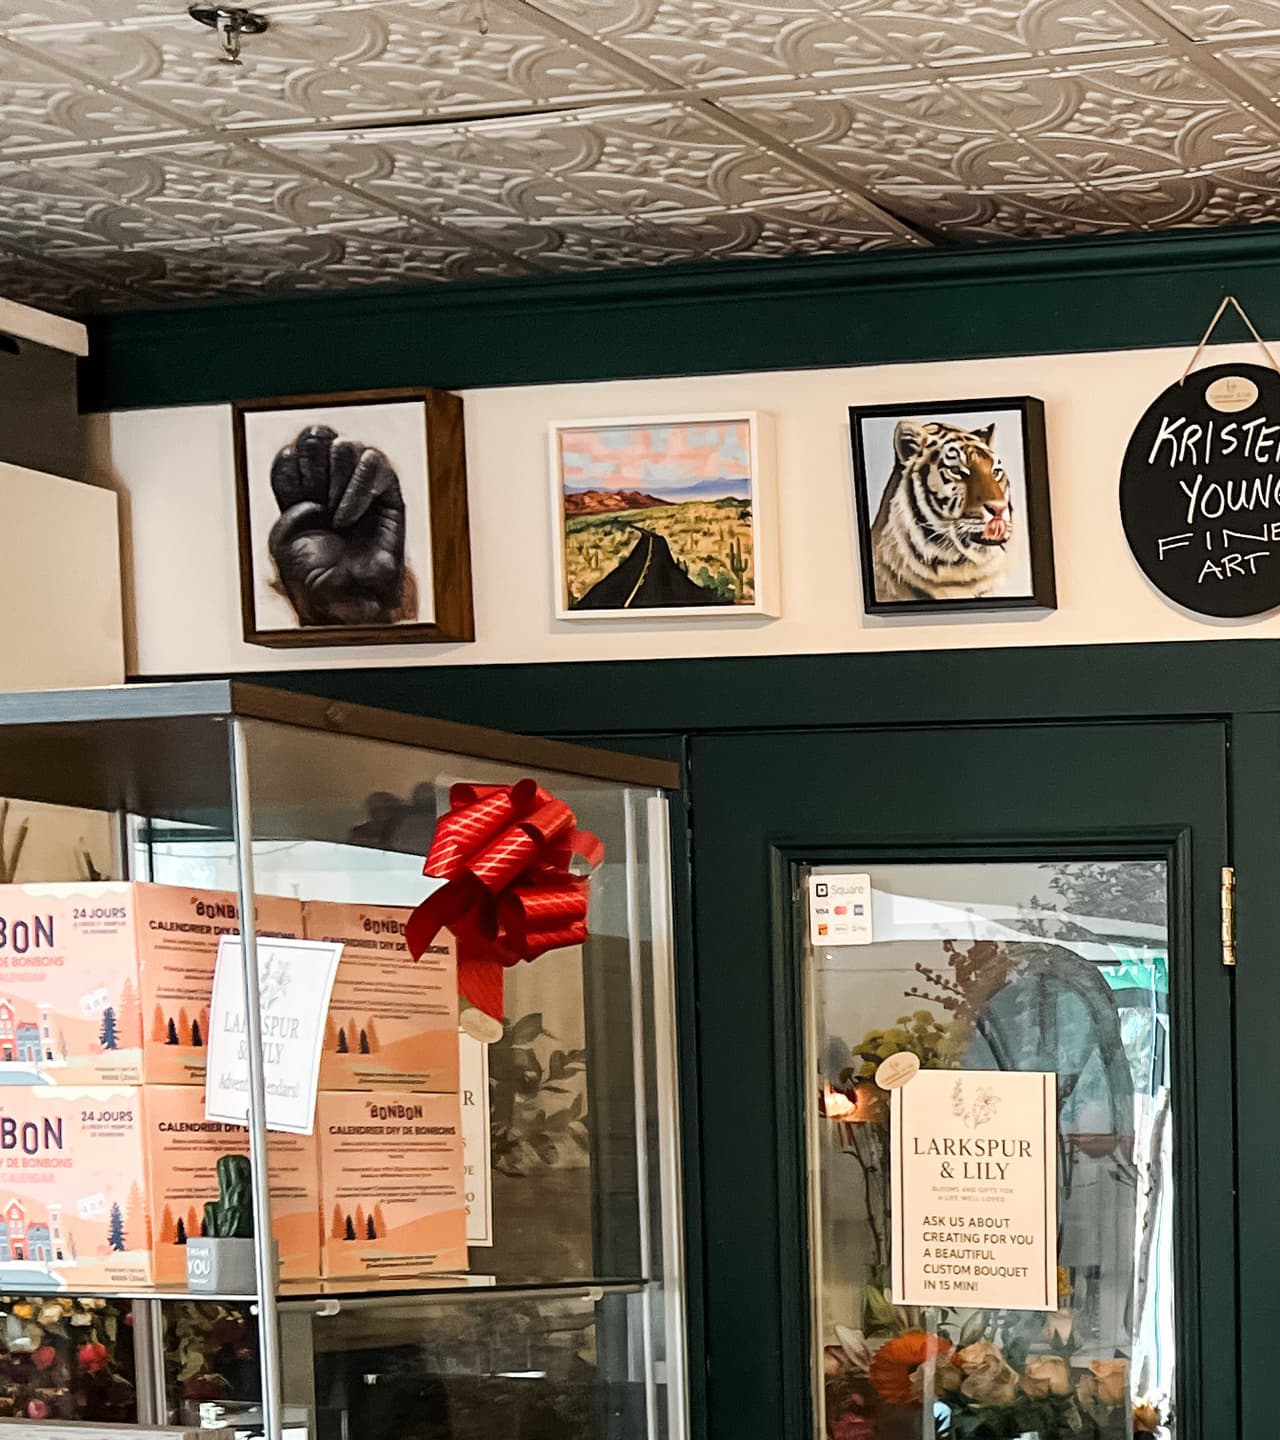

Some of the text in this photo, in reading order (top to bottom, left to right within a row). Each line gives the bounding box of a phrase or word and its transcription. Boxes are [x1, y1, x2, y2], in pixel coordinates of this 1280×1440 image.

[1198, 552, 1270, 583] ART
[831, 885, 864, 896] Square
[73, 907, 126, 919] 24 JOURS
[149, 920, 212, 935] CALENDRIER
[224, 1011, 300, 1039] LASPUR
[81, 1111, 133, 1122] 24 JOURS
[371, 1105, 423, 1120] BONBON
[159, 1122, 222, 1133] CALENDRIER
[329, 1126, 456, 1135] CALENDRIER DIY DE BONBONS
[913, 1137, 1032, 1158] LARKSPUR
[6, 1157, 72, 1168] DE BONBONS
[940, 1161, 1010, 1180] & LILY
[922, 1216, 1011, 1228] ASK US ABOUT
[922, 1232, 1033, 1245] CREATING FOR YOU
[923, 1248, 995, 1260] A BEAUTIFUL
[188, 1261, 210, 1274] YOU
[923, 1264, 1029, 1278] CUSTOM BOUQUET
[924, 1280, 978, 1291] IN 15 MIN!
